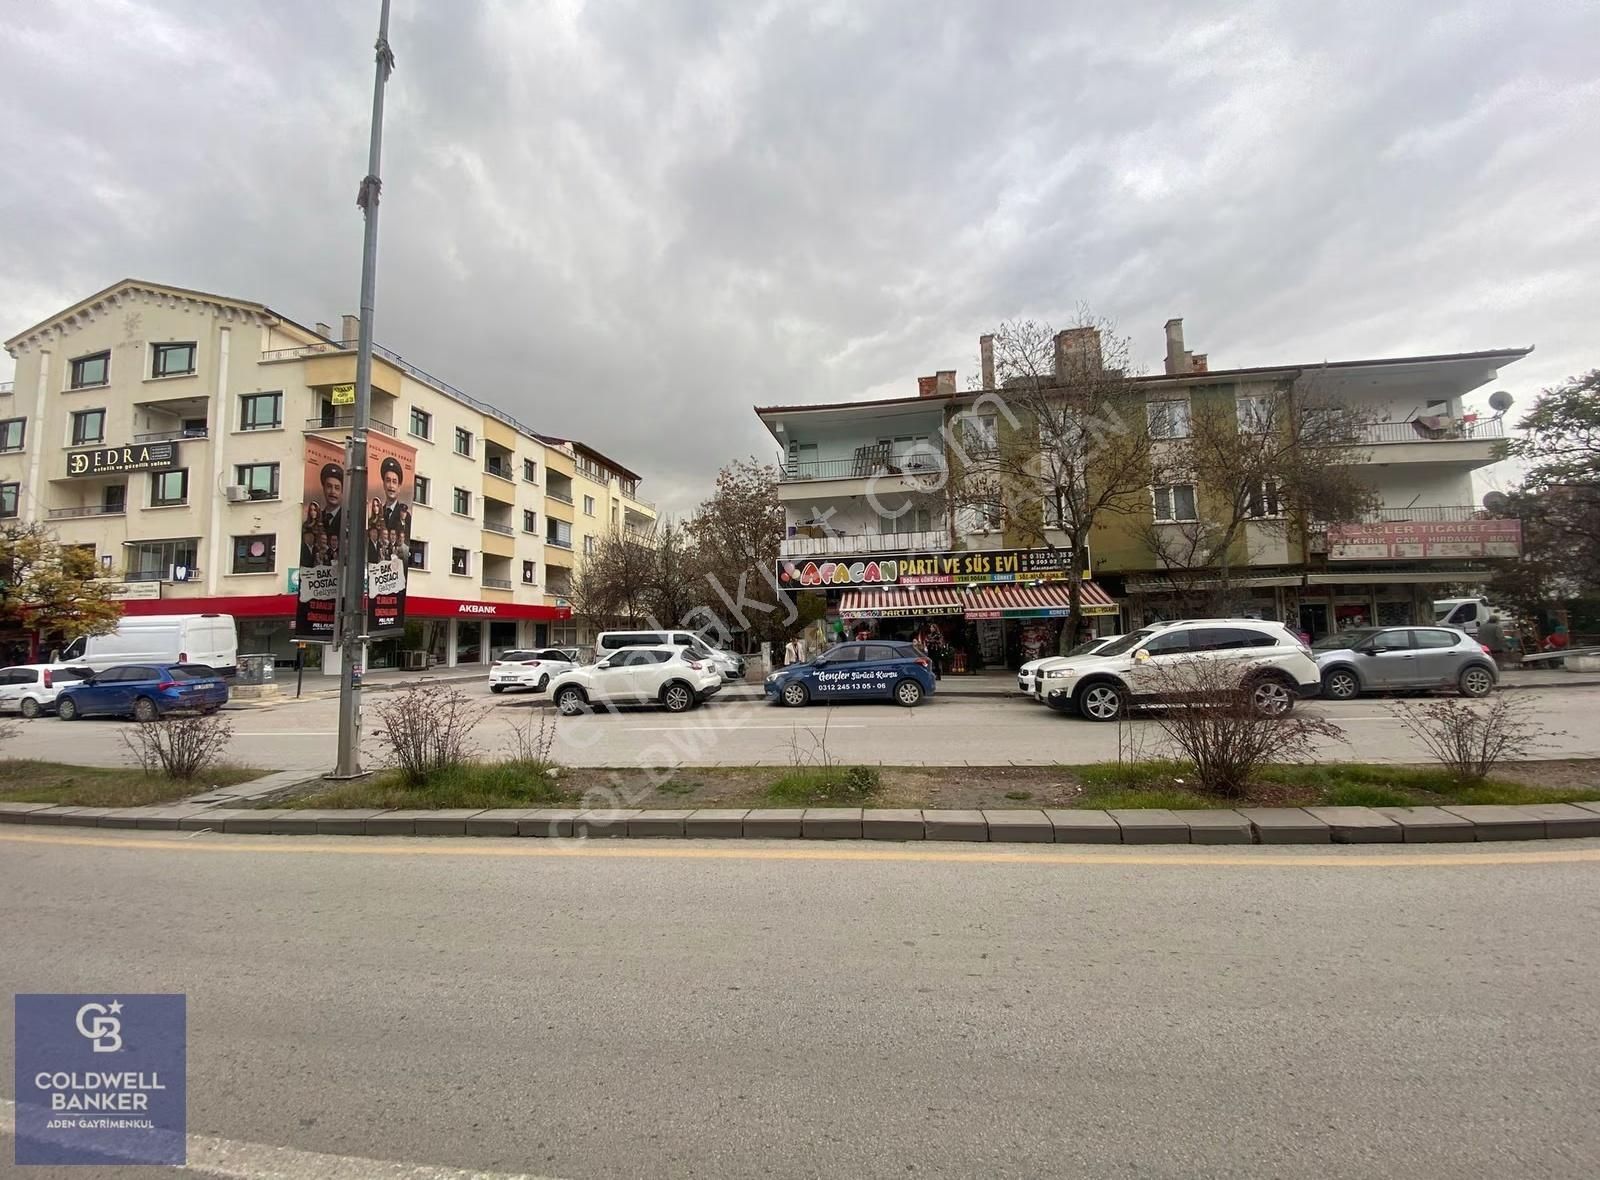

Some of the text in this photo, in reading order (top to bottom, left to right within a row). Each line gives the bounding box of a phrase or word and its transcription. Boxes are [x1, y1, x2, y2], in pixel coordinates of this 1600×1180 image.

[94, 447, 150, 466] EDRA
[316, 569, 332, 579] BAK
[380, 563, 392, 574] BAK
[800, 553, 1018, 585] AFACAN PARTİ VE SÜS EVİ
[308, 578, 338, 590] POSTAC
[459, 604, 497, 614] AKBANK
[818, 671, 850, 682] Gençler
[851, 671, 874, 680] Sürücü
[875, 670, 898, 680] Kursu
